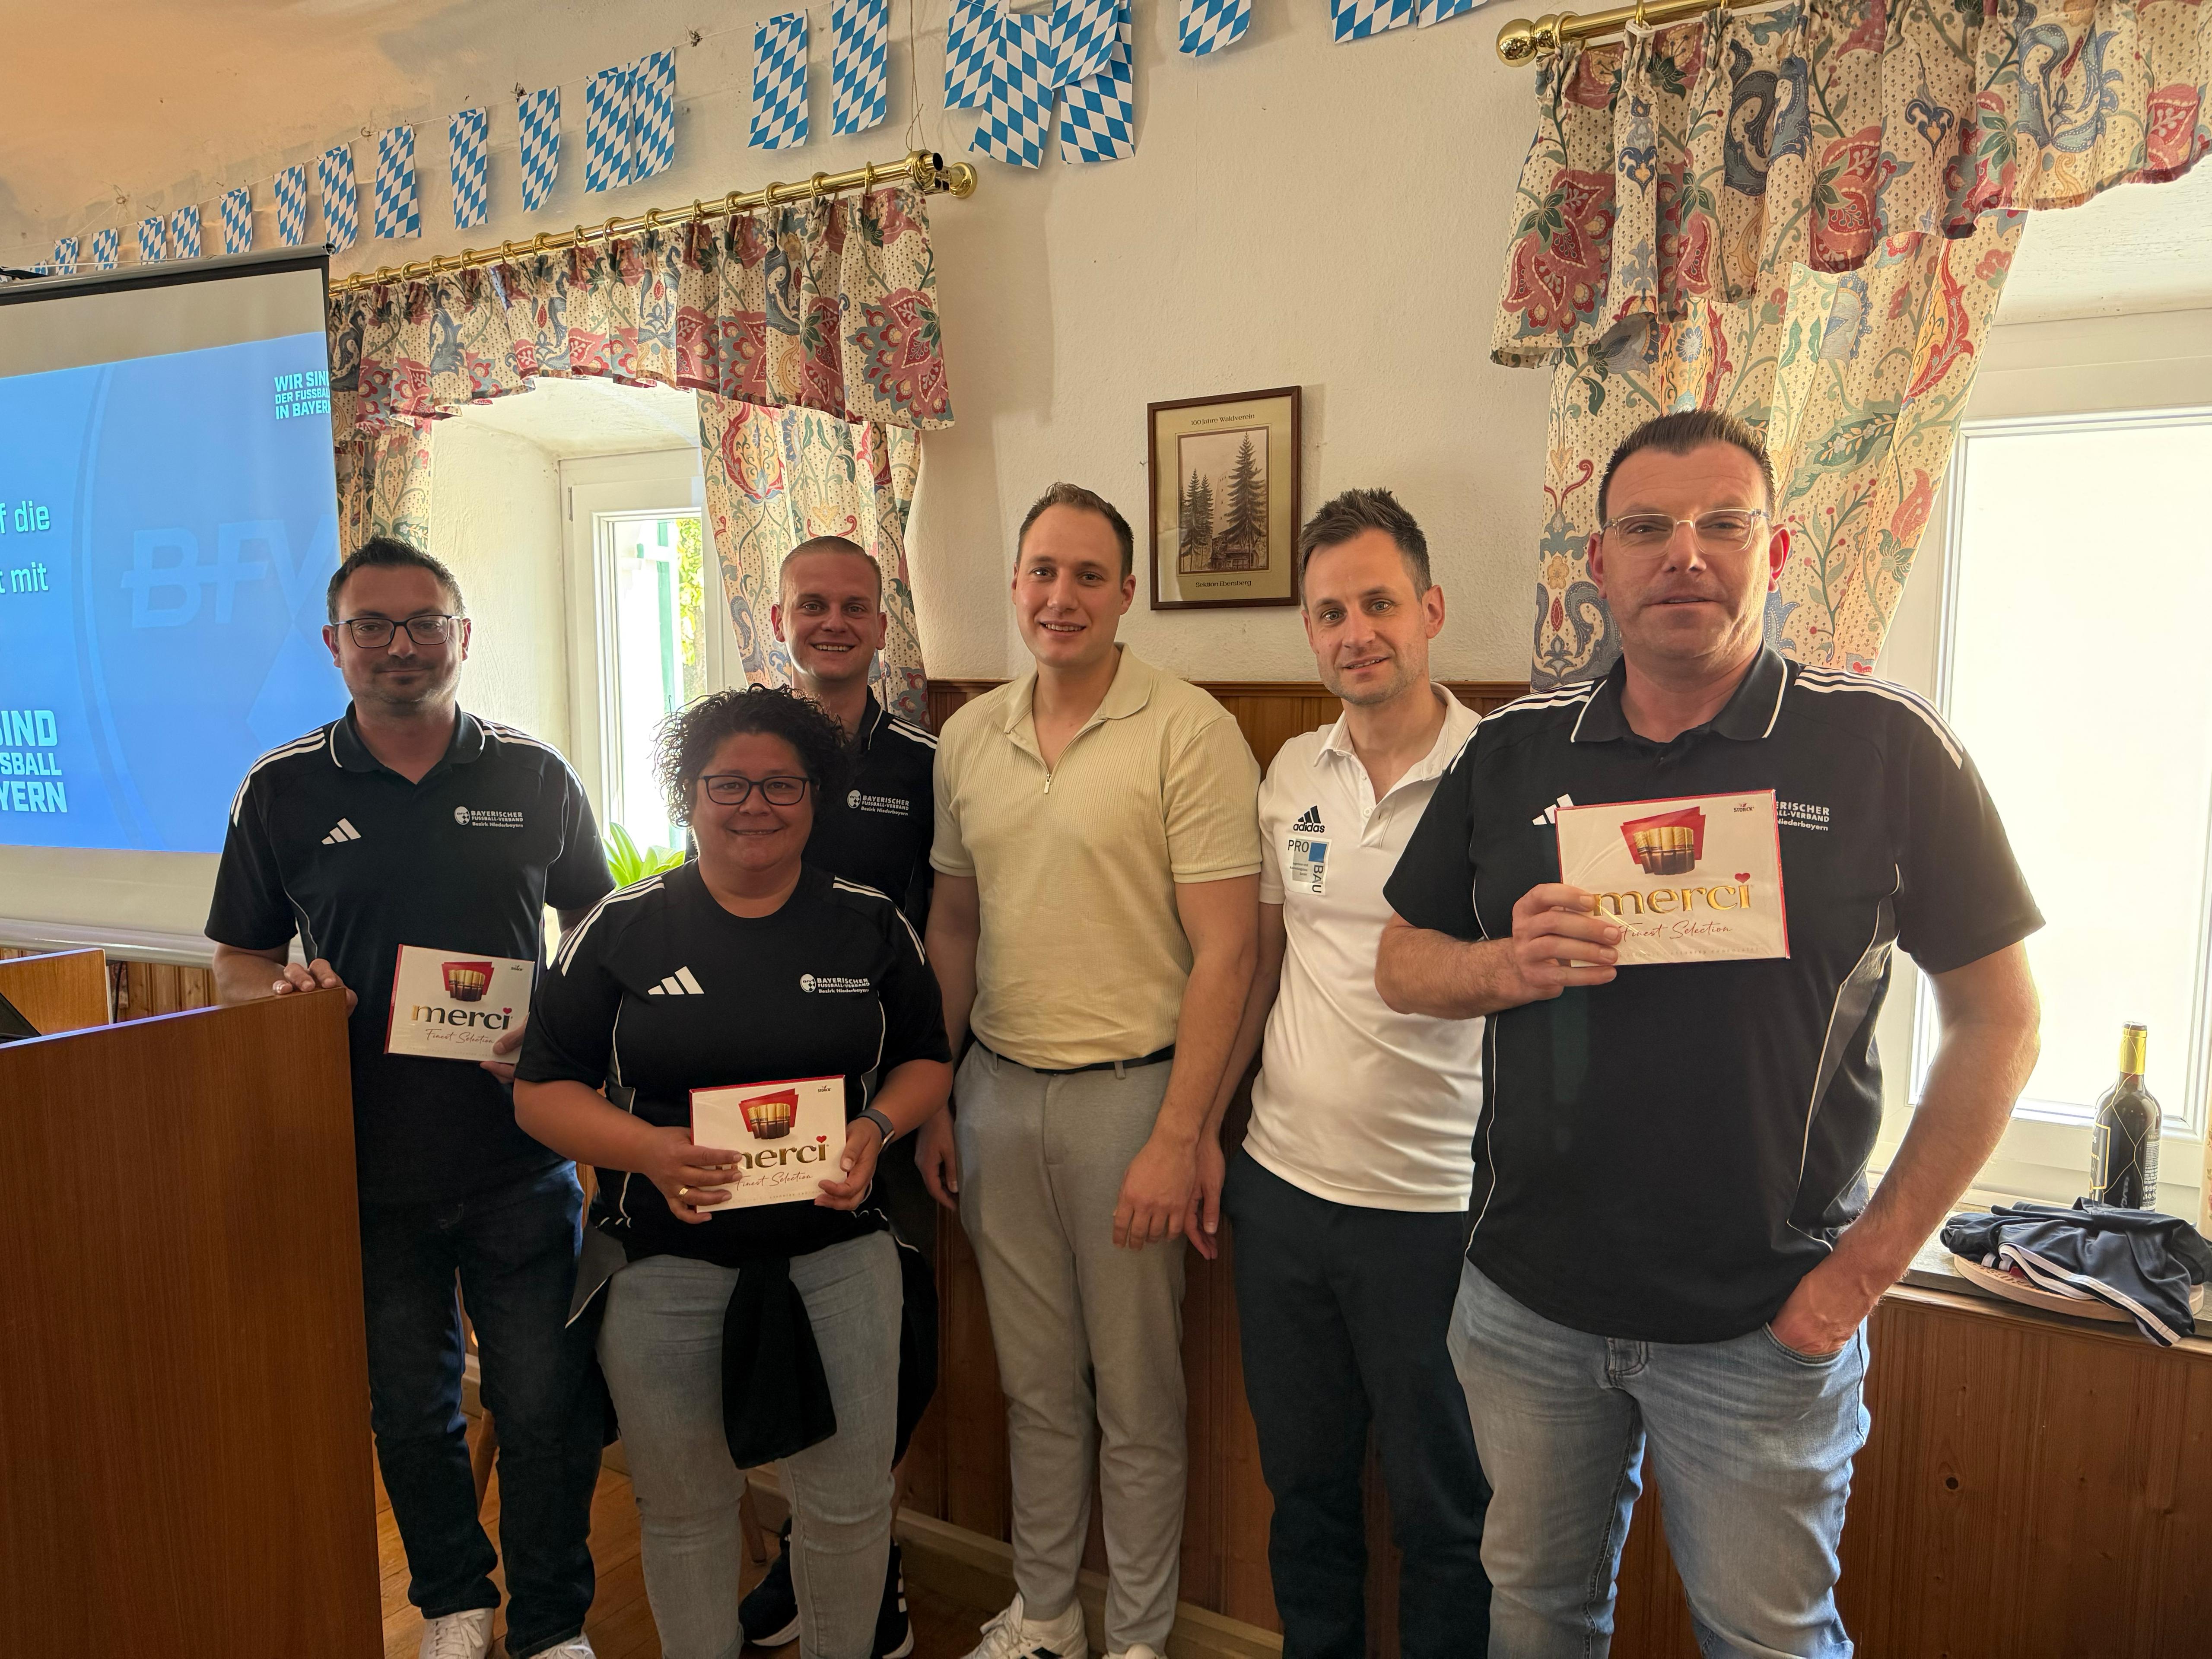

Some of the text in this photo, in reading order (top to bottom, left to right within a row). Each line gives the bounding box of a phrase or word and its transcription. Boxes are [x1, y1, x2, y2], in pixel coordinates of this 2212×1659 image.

[274, 373, 303, 392] WIR
[275, 392, 293, 404] DER
[276, 404, 289, 420] IN
[1219, 413, 1255, 422] Waldverein
[15, 500, 50, 532] die
[11, 562, 48, 593] mit
[0, 710, 57, 747] IND
[861, 801, 909, 810] FUSSBALL-VERBAND
[863, 795, 909, 806] BAYERISCHER
[1293, 822, 1325, 833] adidas
[1288, 839, 1309, 853] PRO
[1312, 864, 1324, 893] BAU
[1593, 872, 1751, 916] merci
[1619, 920, 1733, 942] Finest Selection
[412, 1005, 512, 1030] merci
[426, 1028, 494, 1044] Finest Selection
[769, 1171, 813, 1187] Selection
